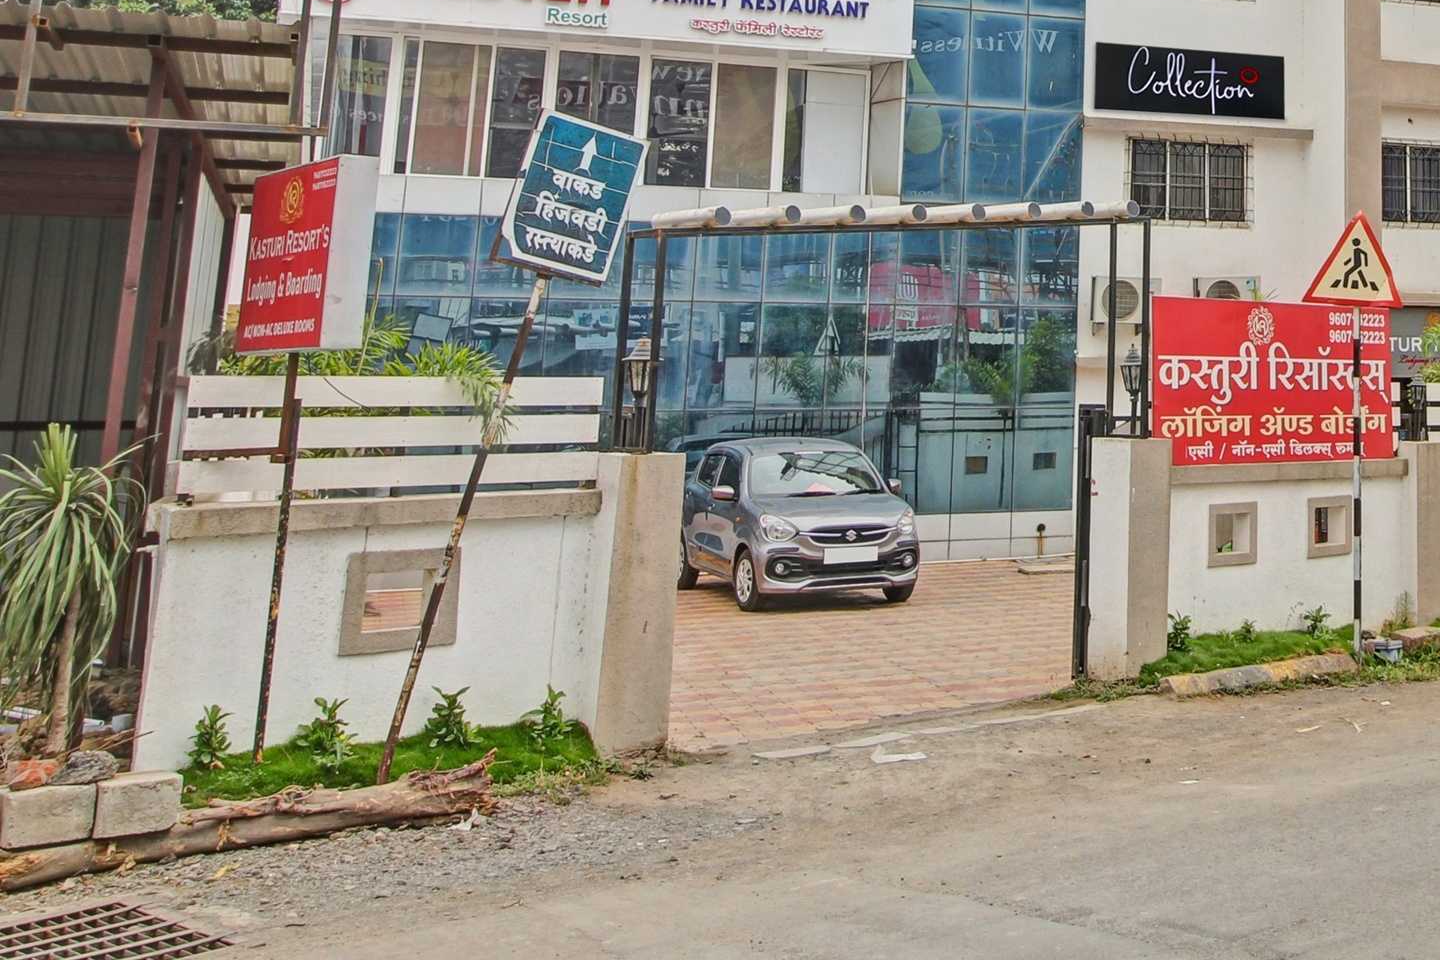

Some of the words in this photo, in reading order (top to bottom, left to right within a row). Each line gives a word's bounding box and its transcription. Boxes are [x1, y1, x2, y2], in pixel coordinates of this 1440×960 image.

[546, 7, 608, 28] Resort
[1128, 46, 1254, 115] Collection
[552, 169, 607, 200] वाकड
[249, 233, 286, 261] KASTURI
[247, 273, 277, 306] Lodging
[286, 268, 323, 298] Boarding
[1329, 311, 1385, 328] 96072223
[1329, 329, 1386, 345] 96072223
[1158, 341, 1259, 405] कस्तुरी
[1160, 405, 1252, 438] लॉजिंग
[1187, 440, 1214, 460] एसी
